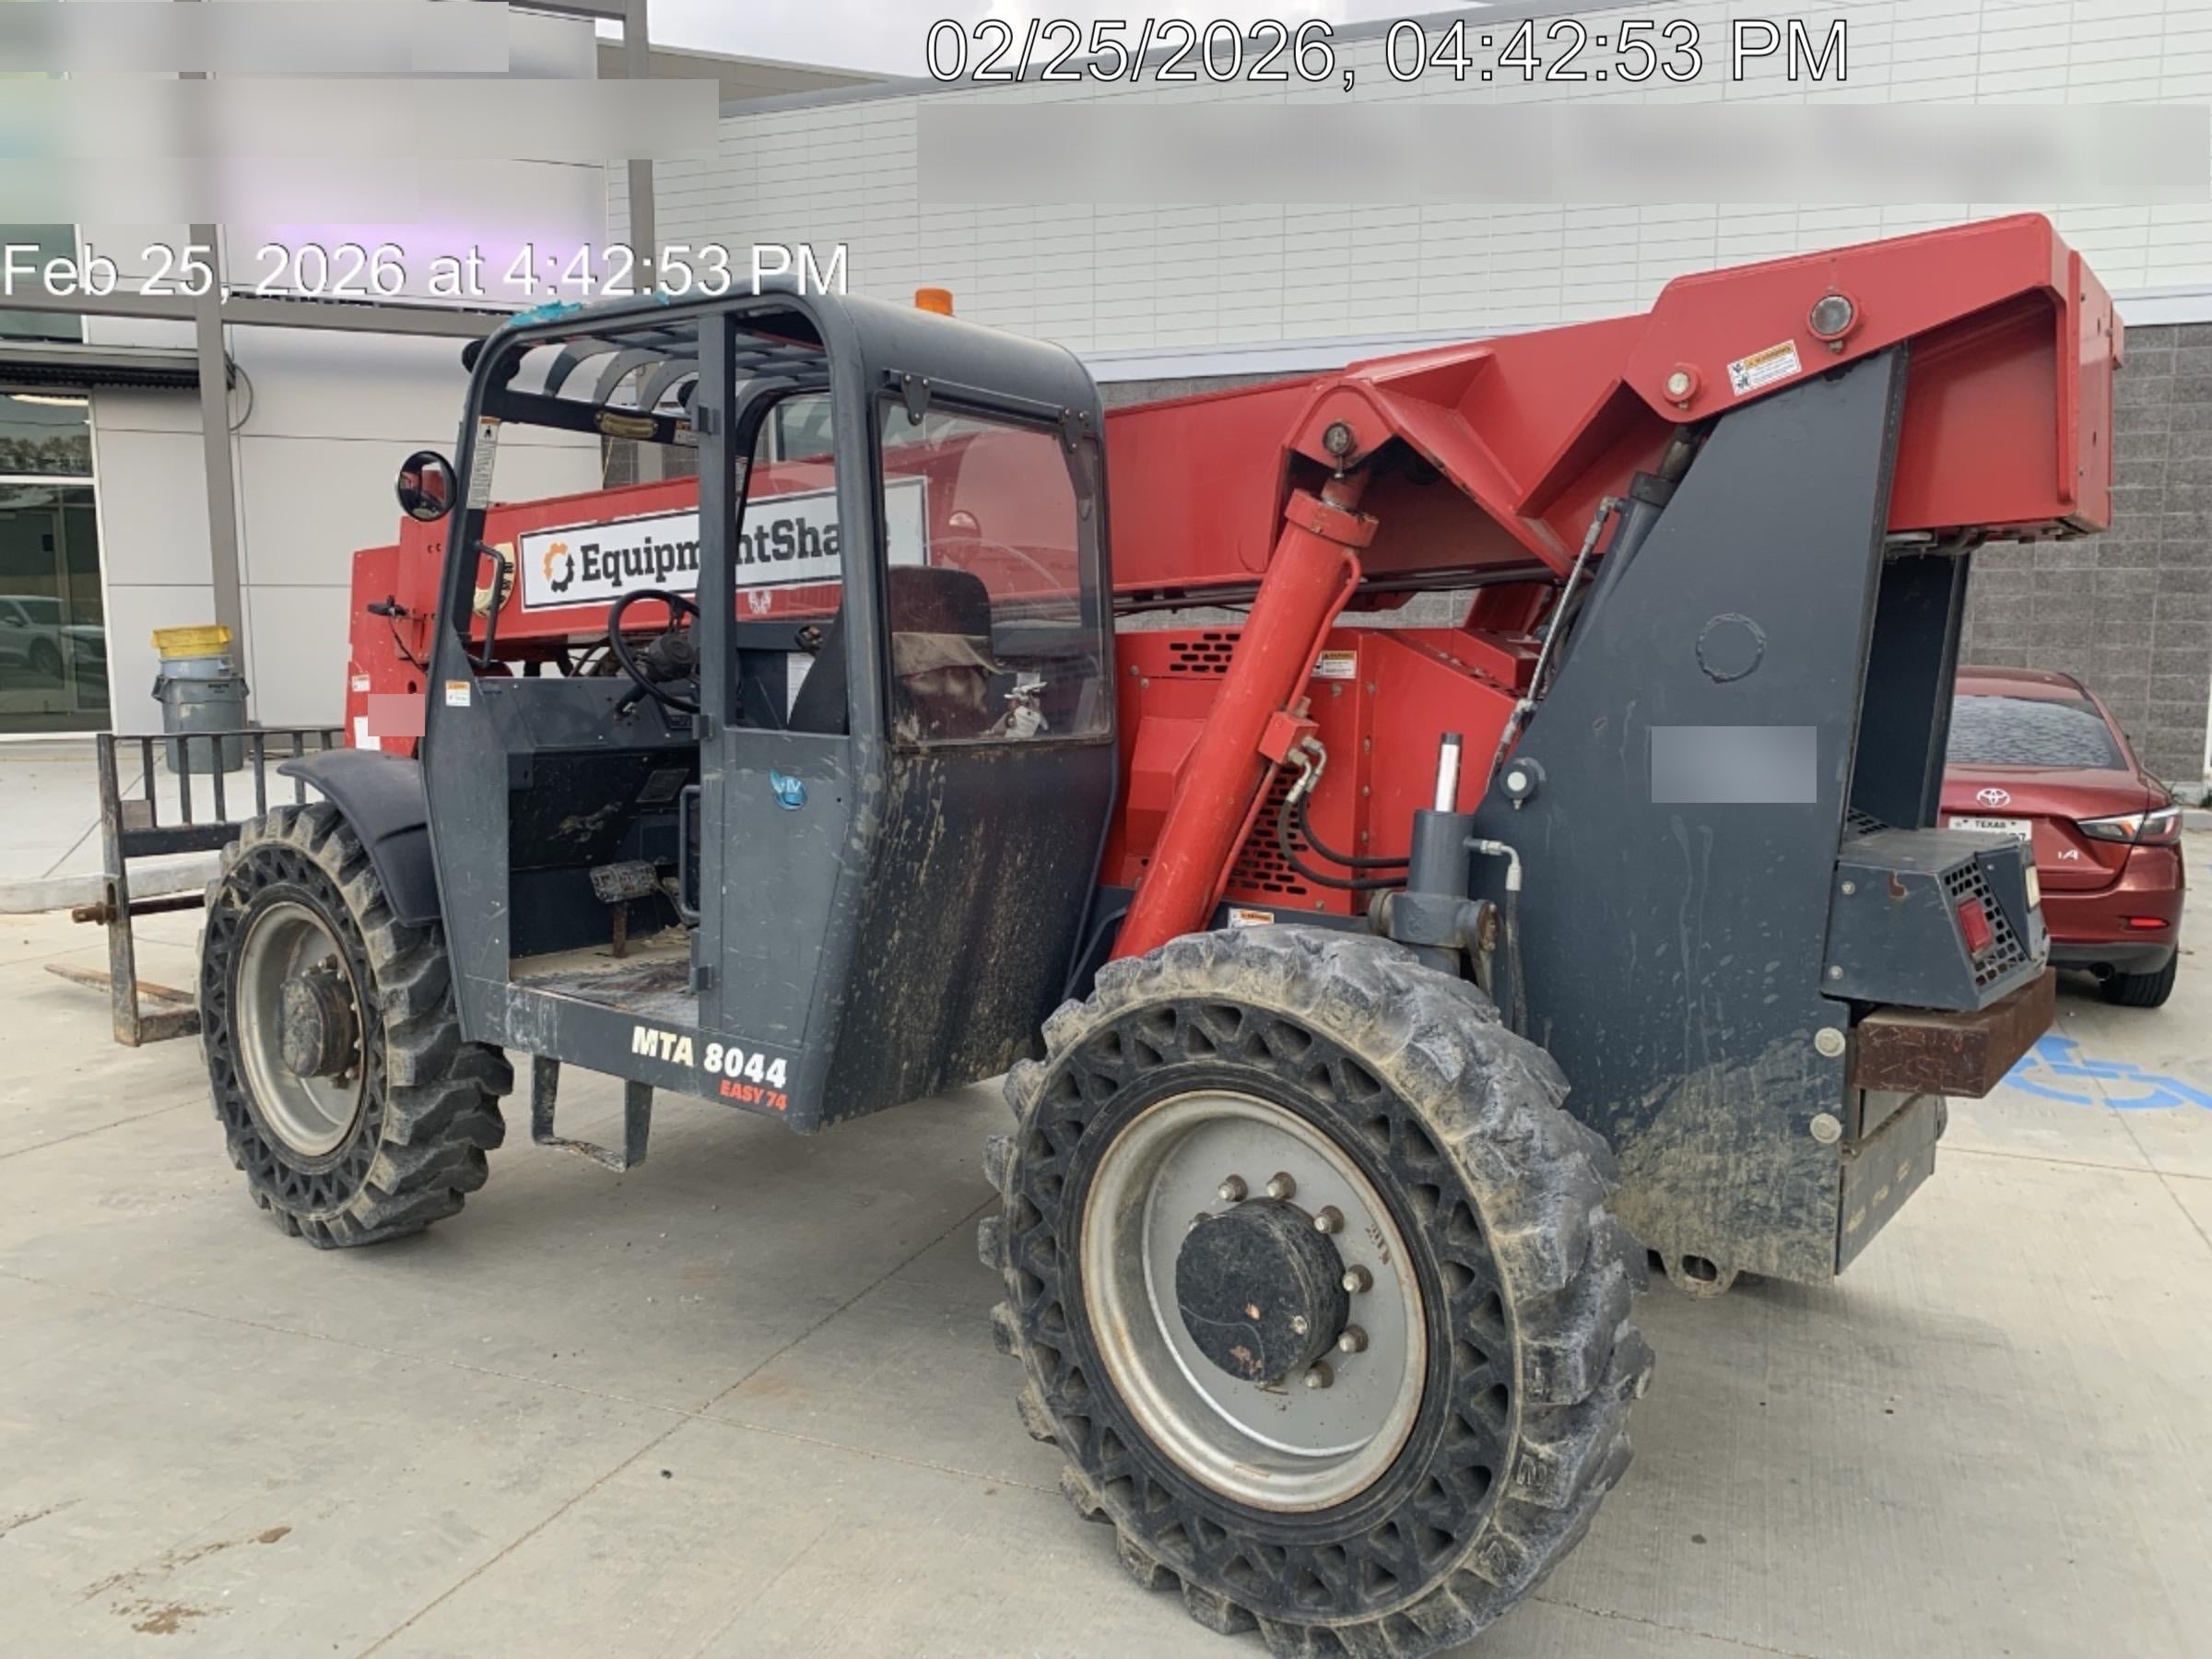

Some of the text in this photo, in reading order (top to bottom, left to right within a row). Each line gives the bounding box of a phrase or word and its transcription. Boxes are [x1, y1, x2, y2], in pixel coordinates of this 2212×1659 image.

[631, 1025, 787, 1088] MTA 8044
[719, 1079, 788, 1111] EASY 74
